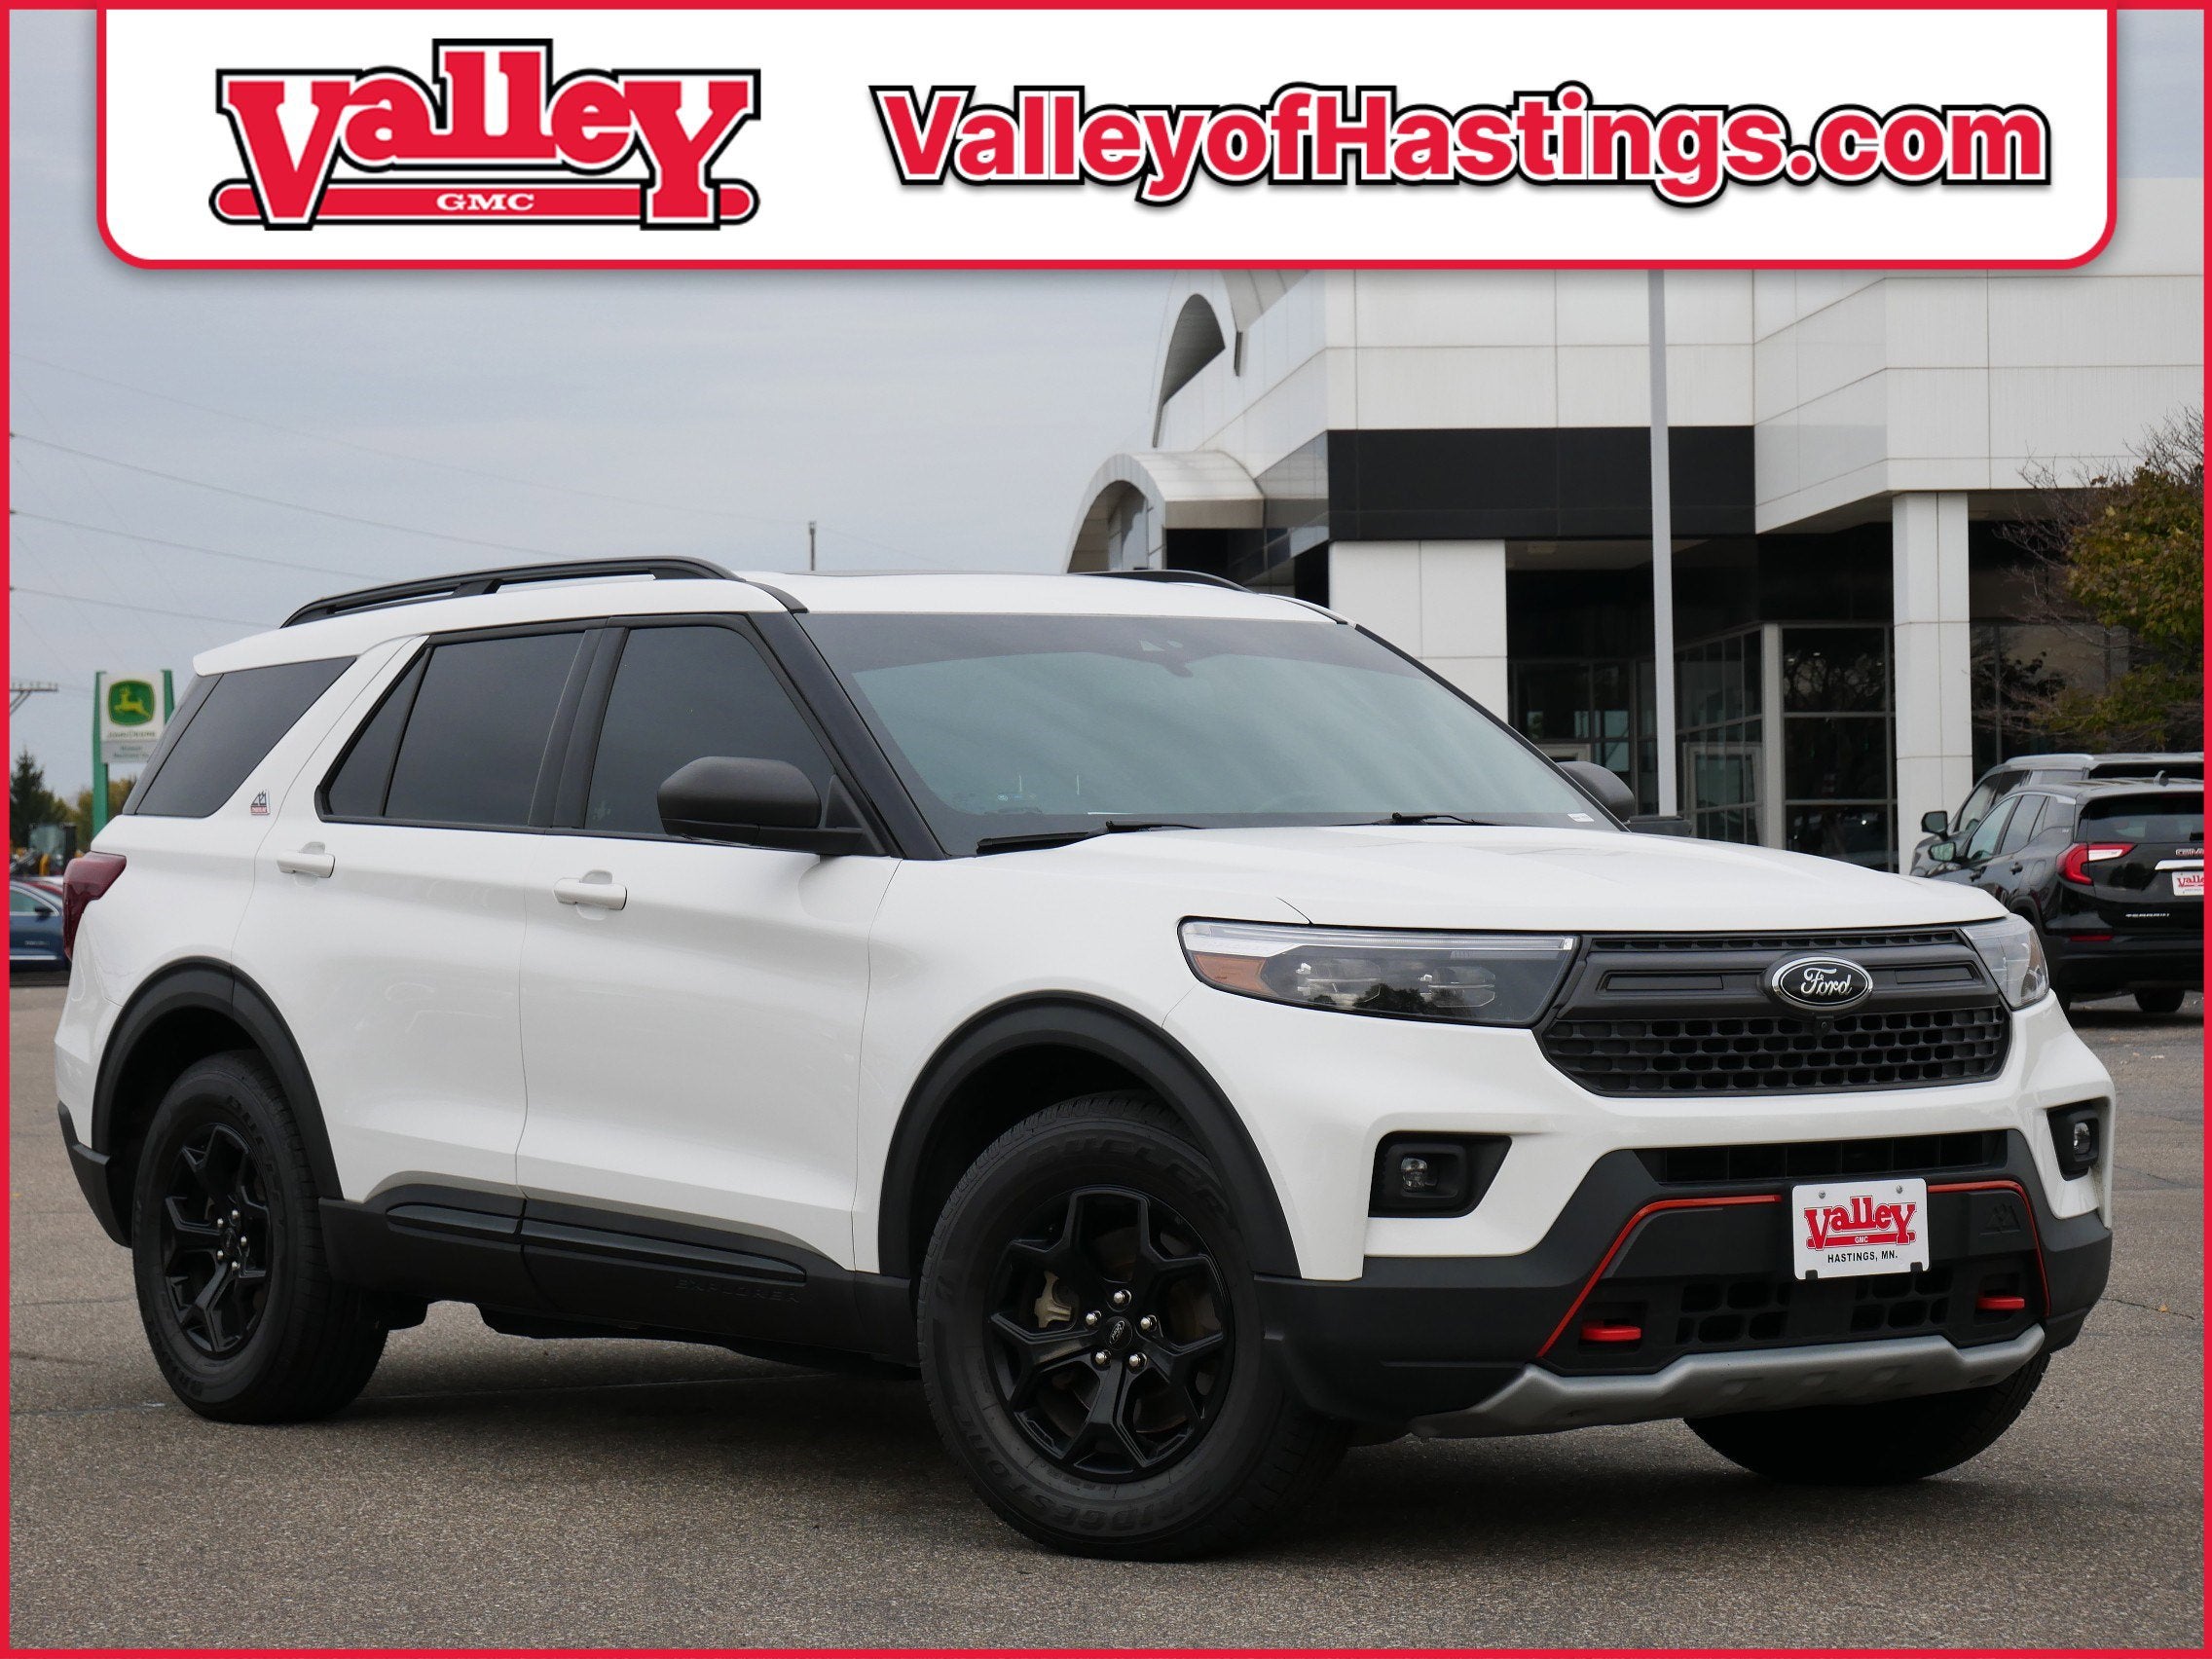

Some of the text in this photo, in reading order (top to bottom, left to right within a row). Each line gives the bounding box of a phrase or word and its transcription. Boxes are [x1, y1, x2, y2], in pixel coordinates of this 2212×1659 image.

[1800, 967, 1853, 996] Ford
[1855, 1235, 1869, 1244] GMC
[1827, 1249, 1899, 1264] HASTINGS, MN.
